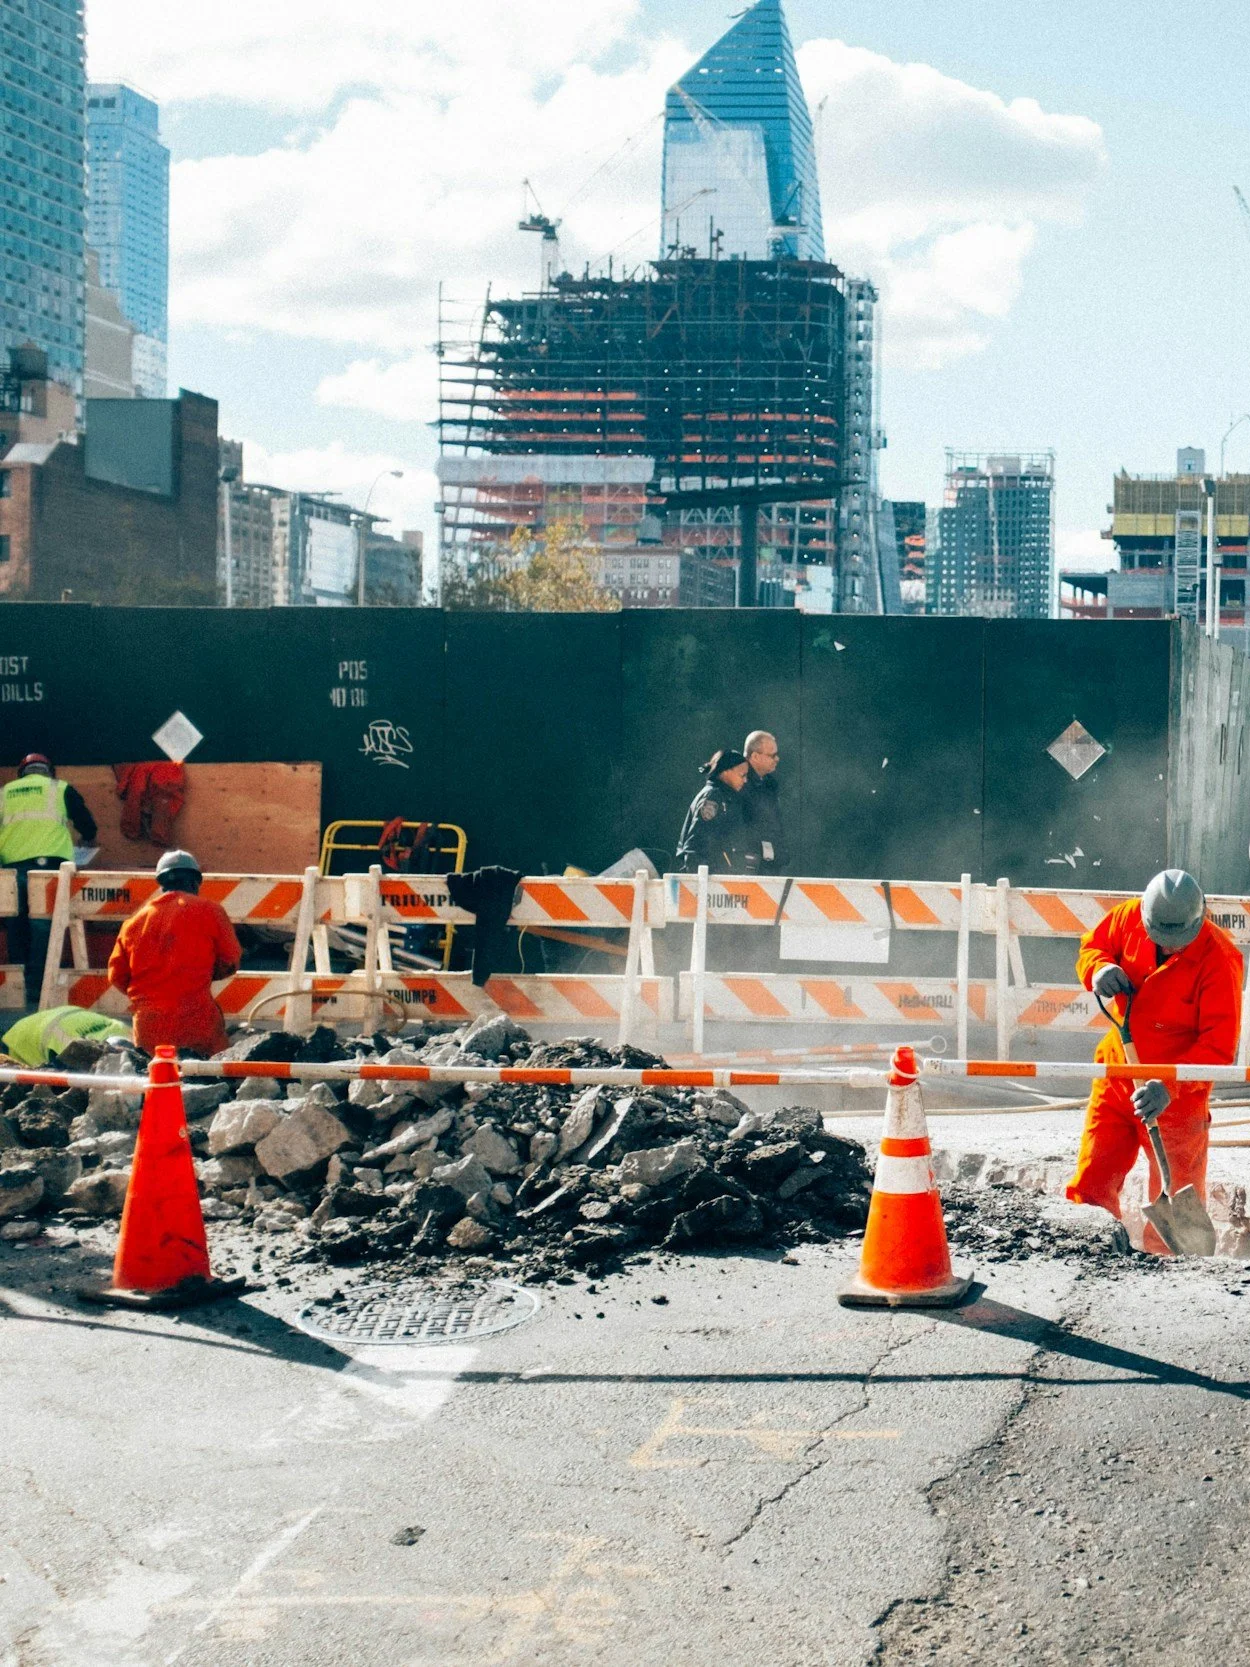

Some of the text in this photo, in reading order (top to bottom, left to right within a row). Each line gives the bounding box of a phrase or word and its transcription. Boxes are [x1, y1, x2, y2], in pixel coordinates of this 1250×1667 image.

[1, 682, 43, 702] BILLS
[81, 886, 130, 903] TRIUMPH
[705, 893, 749, 909] RIUMPH
[387, 988, 437, 1004] TRIUMPH
